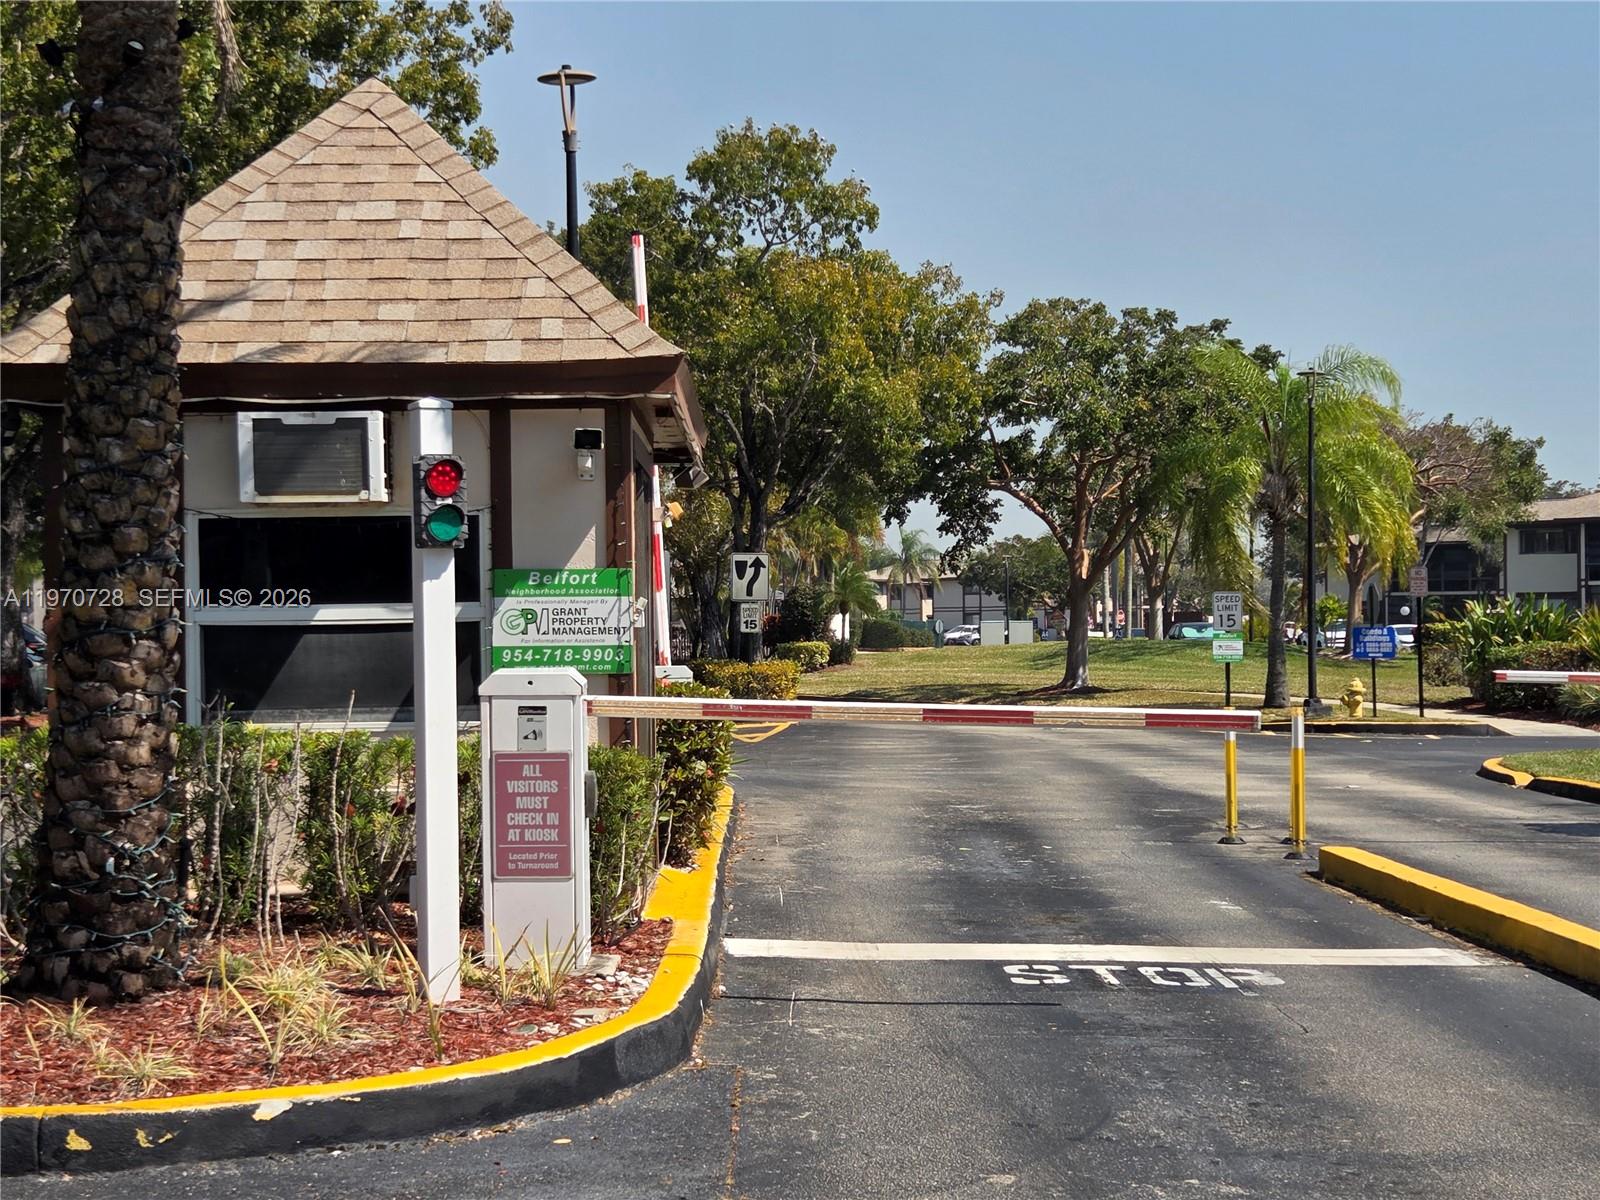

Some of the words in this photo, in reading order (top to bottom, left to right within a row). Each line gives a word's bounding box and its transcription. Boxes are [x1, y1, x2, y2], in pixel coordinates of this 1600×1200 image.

[528, 571, 598, 585] Belfort
[505, 587, 566, 596] Neighborhood
[1215, 595, 1240, 603] SPEED
[551, 607, 588, 617] GRANT
[1217, 604, 1239, 612] LIMIT
[551, 617, 607, 626] PROPERTY
[743, 619, 758, 630] 15
[1219, 614, 1236, 628] 15
[551, 627, 628, 636] MANAGEMENT
[502, 649, 624, 663] 954-718-9903
[522, 764, 543, 777] ALL
[506, 780, 558, 793] VISITORS
[515, 796, 549, 809] MUST
[507, 812, 544, 826] CHECK
[547, 812, 559, 826] IN
[507, 828, 521, 842] AT
[524, 828, 559, 842] KIOSK
[508, 852, 538, 860] Located
[539, 852, 558, 860] Prior
[508, 862, 516, 870] to
[517, 861, 559, 870] Turnaround
[1002, 964, 1286, 994] STOP
